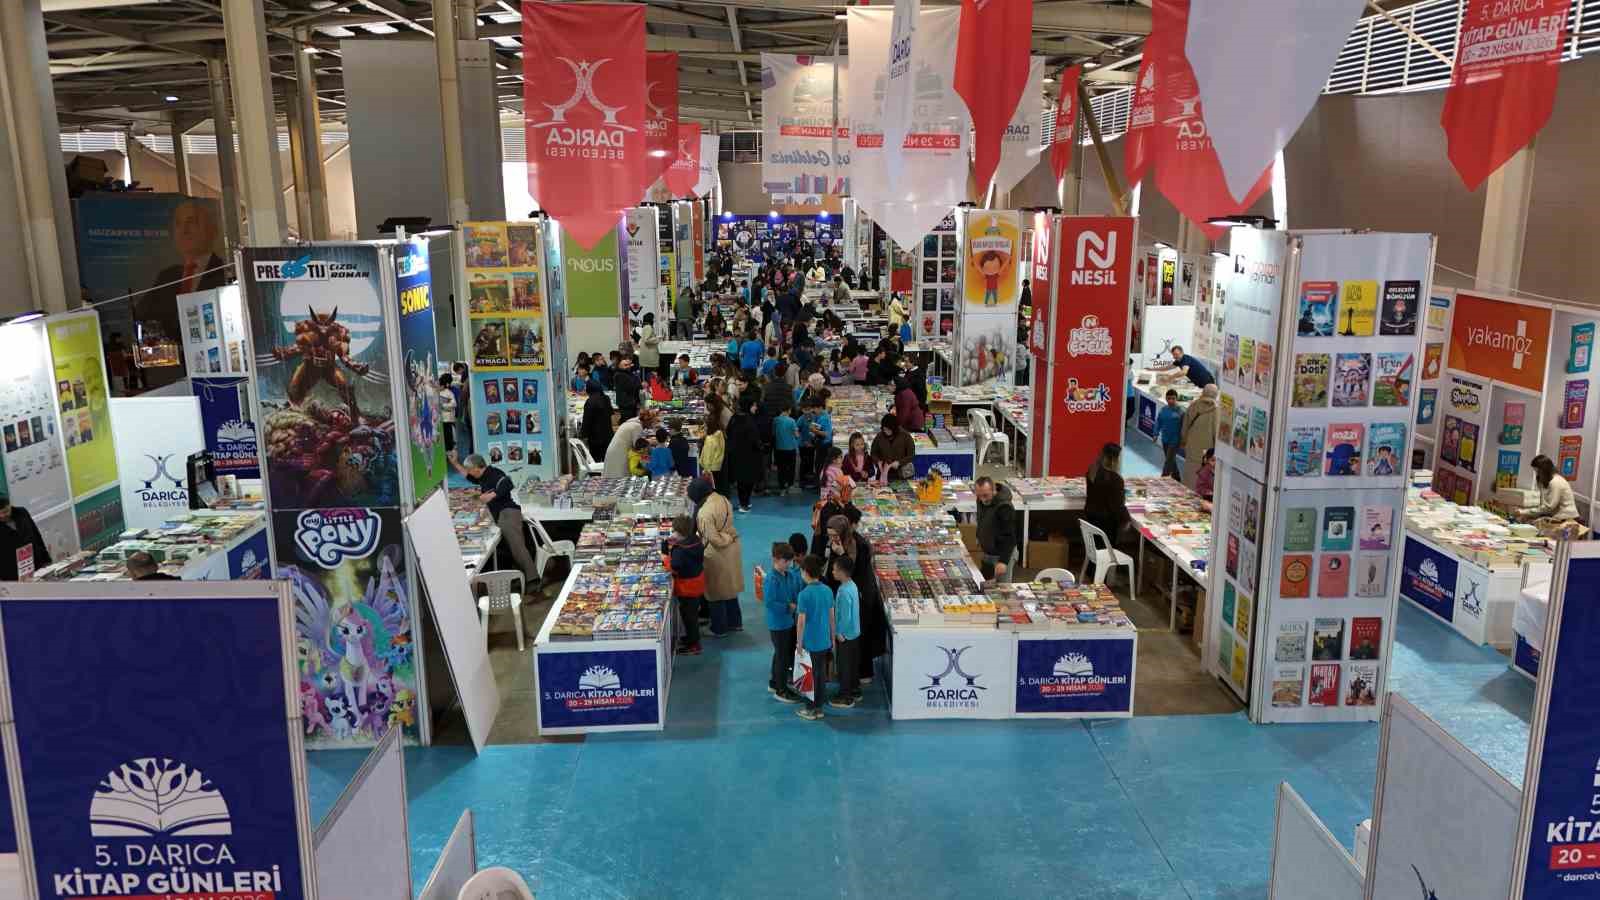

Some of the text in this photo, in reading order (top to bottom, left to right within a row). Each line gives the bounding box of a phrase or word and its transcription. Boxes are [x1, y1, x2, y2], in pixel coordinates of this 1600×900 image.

[1495, 8, 1567, 38] GÜNLERİ
[330, 271, 369, 279] ROMAN
[400, 285, 430, 319] SONIC
[1467, 325, 1533, 356] yakamoz
[1069, 400, 1105, 412] çocuk
[232, 450, 257, 459] GÜNL
[142, 490, 187, 502] DARICA
[300, 518, 374, 562] PONY
[1028, 676, 1060, 686] DARICA
[1061, 674, 1087, 685] KİTAP
[1088, 673, 1127, 685] GÜNLERİ
[554, 691, 586, 700] DARICA
[588, 688, 613, 698] KİTAP
[615, 687, 655, 698] GÜNLERİ
[927, 689, 978, 700] DARICA
[1066, 684, 1087, 692] NİSAN
[1546, 815, 1600, 843] KİTA
[95, 842, 236, 867] 5. DARICA
[1558, 848, 1582, 864] 20
[54, 864, 282, 896] KİTAP GÜNLERİ
